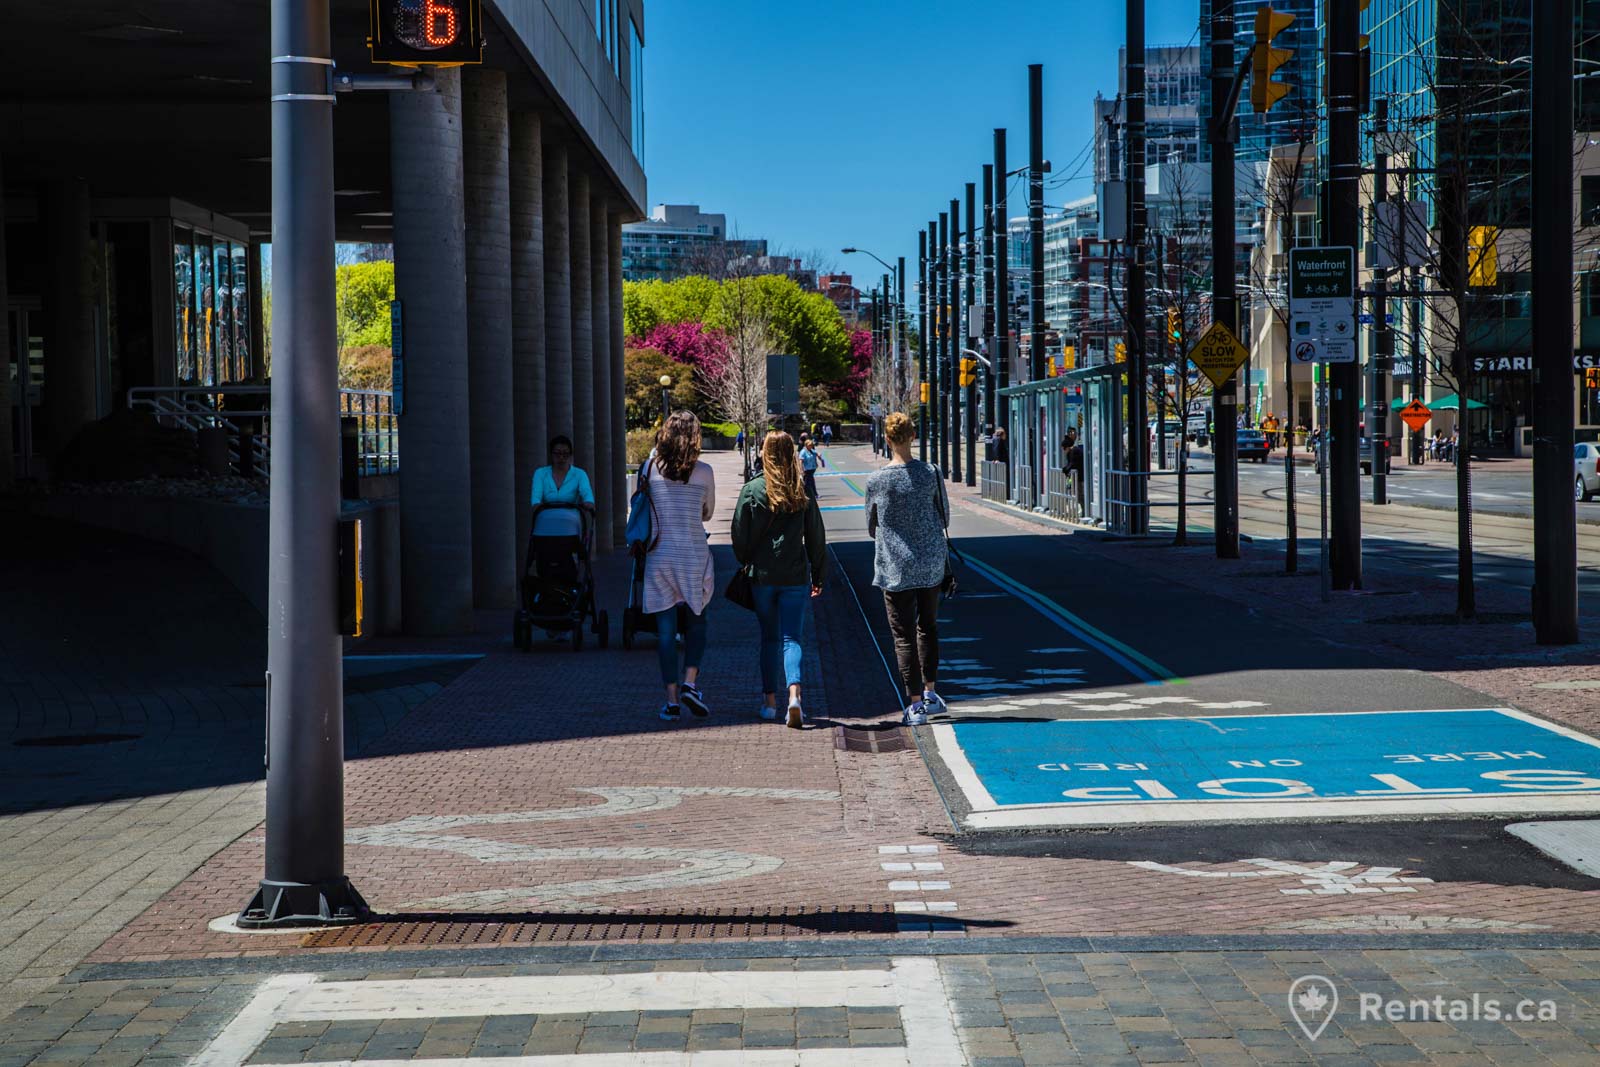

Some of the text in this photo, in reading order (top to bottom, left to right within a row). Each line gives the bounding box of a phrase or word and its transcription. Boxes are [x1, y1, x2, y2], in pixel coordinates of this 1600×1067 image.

[425, 0, 455, 44] 6
[1297, 260, 1346, 271] Waterfront
[1202, 346, 1236, 357] SLOW
[1473, 355, 1593, 371] STARKS
[1037, 749, 1546, 771] HERE ON RED
[1062, 768, 1600, 799] STOP
